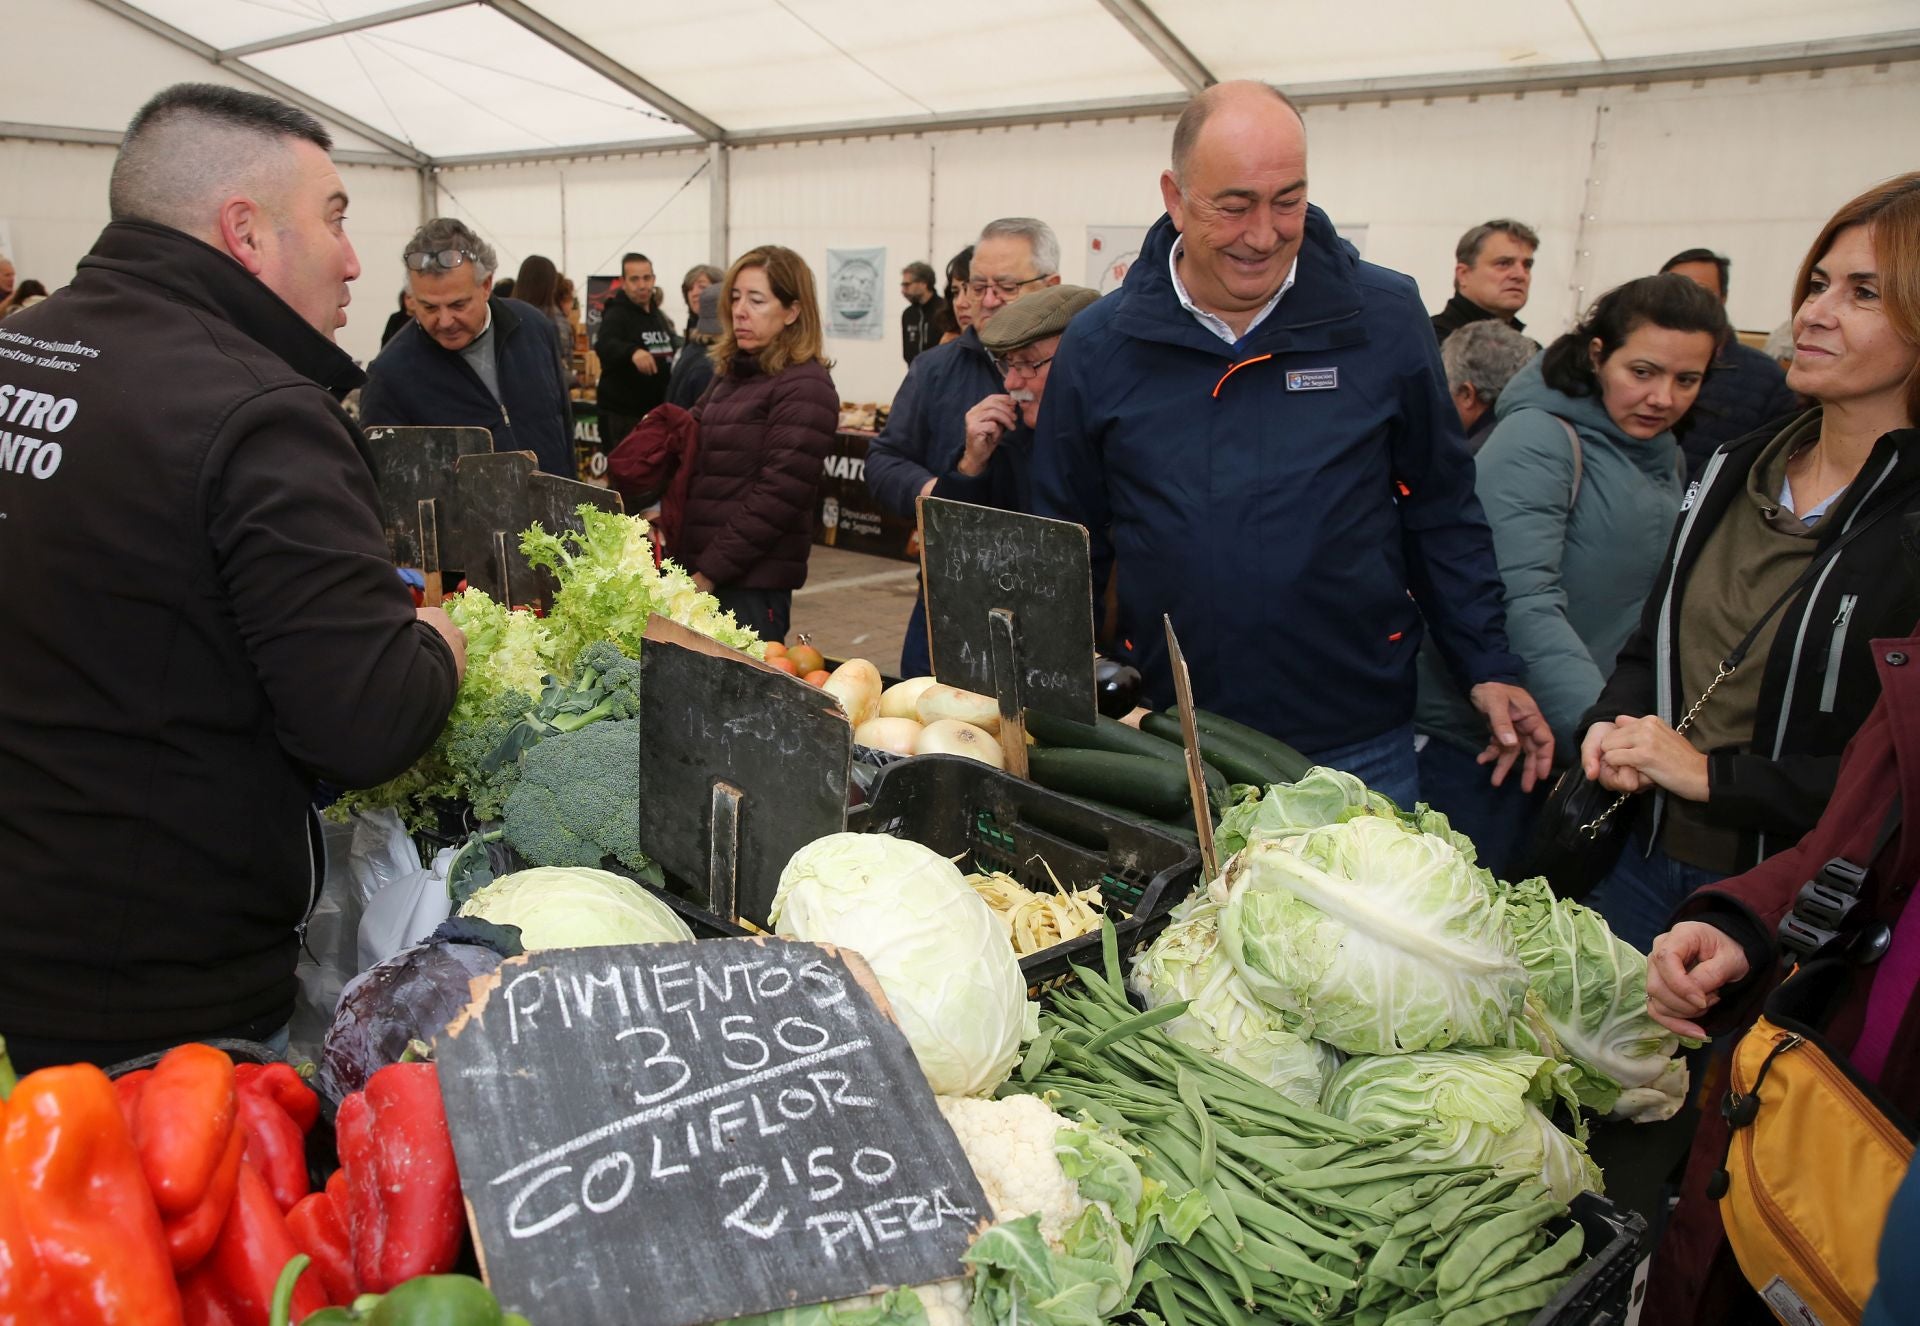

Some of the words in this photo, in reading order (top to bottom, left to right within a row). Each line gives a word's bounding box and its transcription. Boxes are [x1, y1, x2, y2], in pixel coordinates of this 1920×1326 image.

[33, 339, 101, 358] costumbres
[0, 430, 63, 480] NTO
[503, 959, 848, 1044] PIMIENTOS
[508, 1071, 876, 1240] COLIFLOR
[805, 1187, 977, 1260] PIEZA
